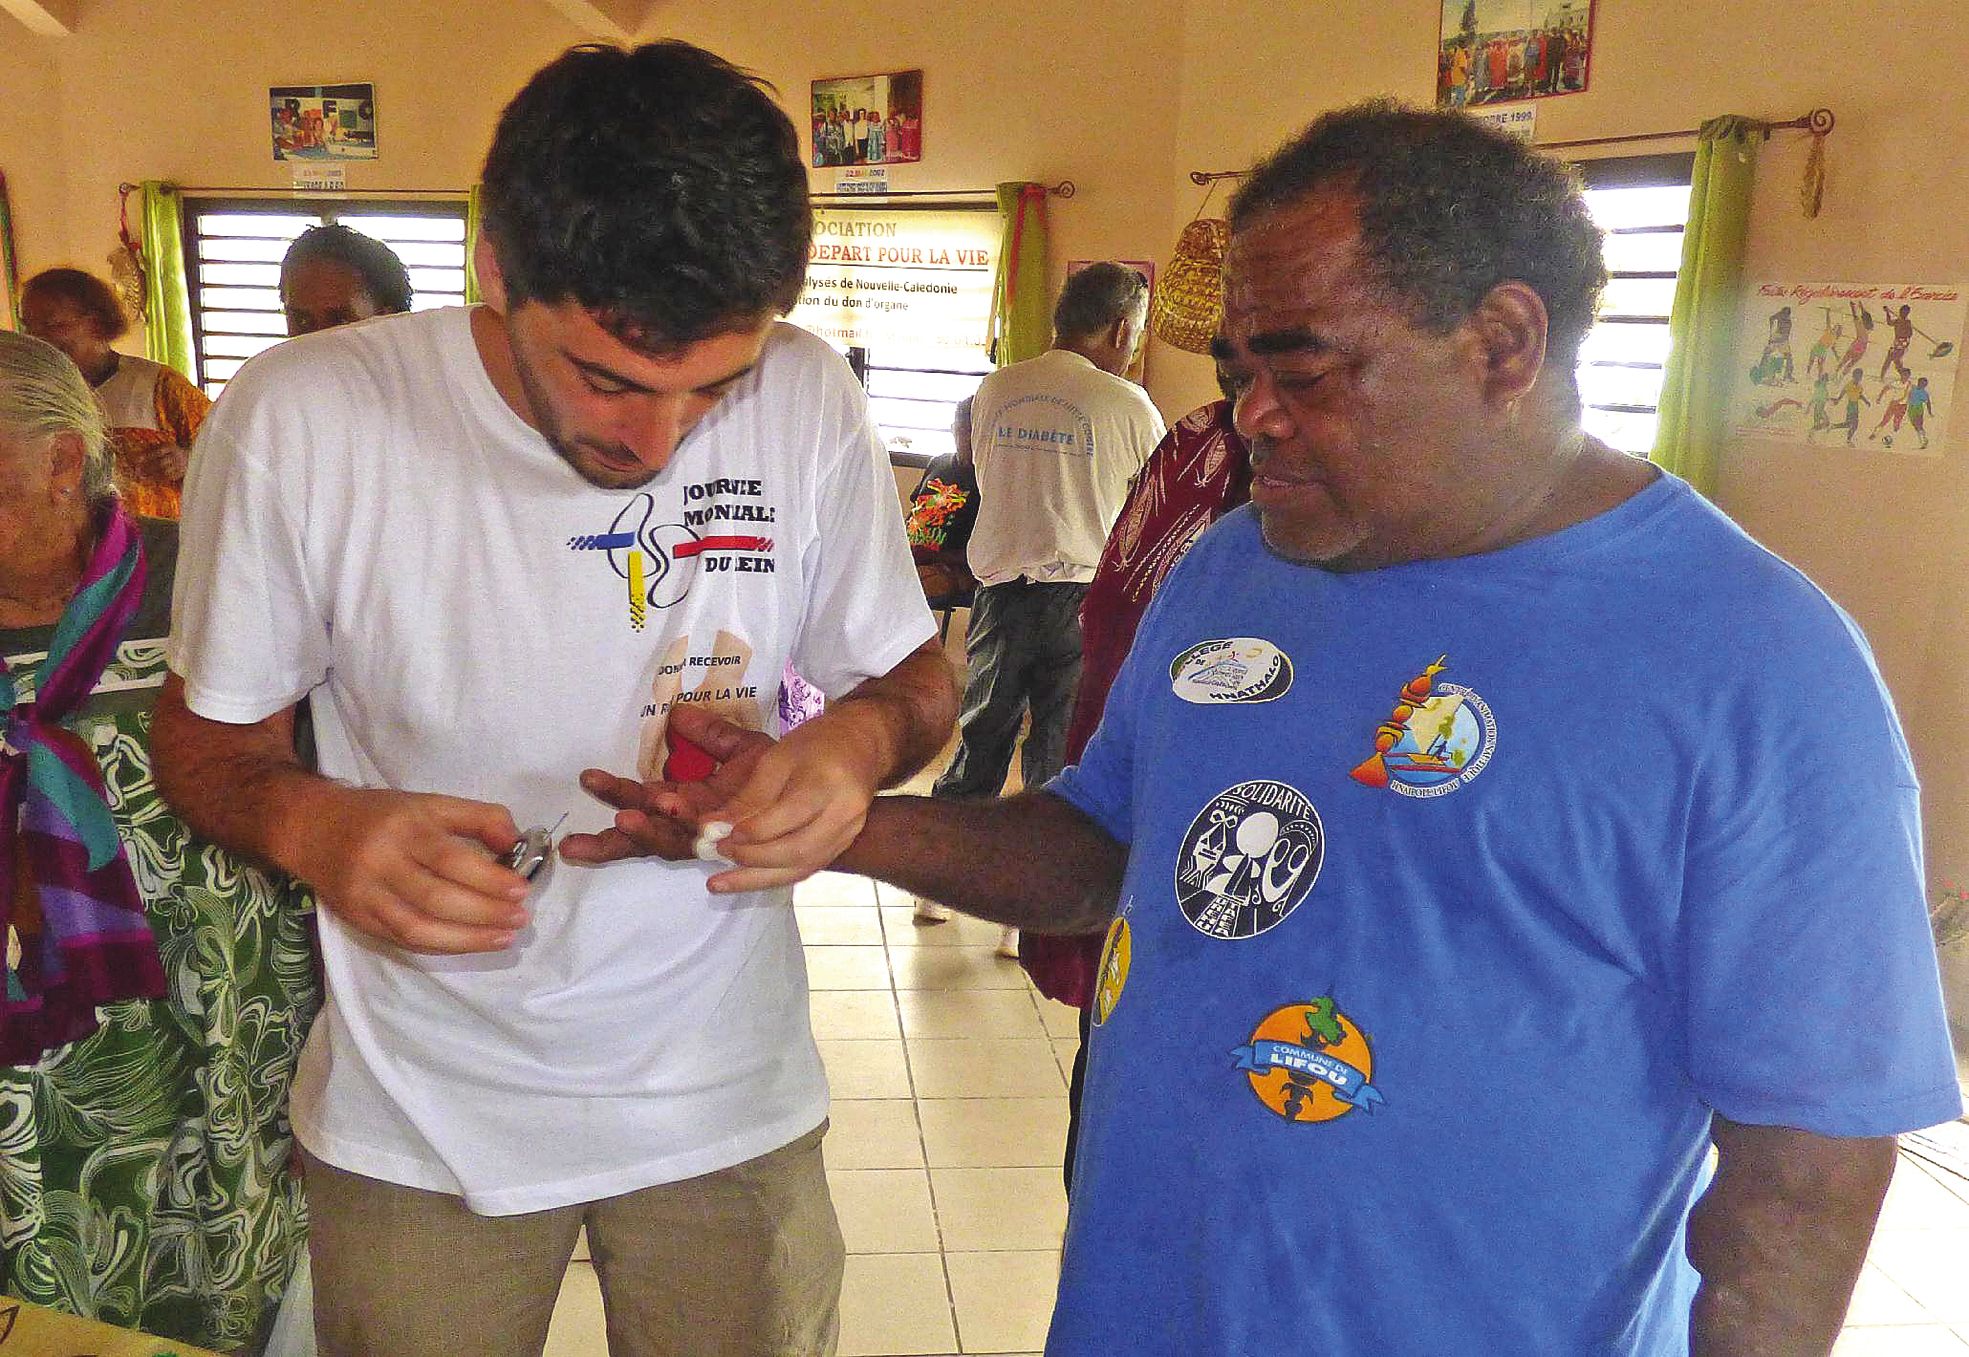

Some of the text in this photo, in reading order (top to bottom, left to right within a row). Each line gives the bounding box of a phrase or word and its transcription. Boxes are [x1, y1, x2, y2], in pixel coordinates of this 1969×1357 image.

[813, 221, 897, 237] OCIATION
[808, 245, 990, 266] DEPART POUR LA VIE
[803, 276, 837, 290] alysés
[840, 277, 854, 289] de
[797, 295, 909, 313] tion du don d'organe
[998, 426, 1013, 439] LE
[683, 504, 775, 527] MONIAL
[705, 557, 775, 573] DU EIN
[689, 655, 741, 667] RECEVOIR
[1209, 655, 1279, 700] HNATHALO
[676, 690, 712, 703] POUR
[716, 688, 731, 700] LA
[736, 686, 757, 699] VIE
[1272, 1045, 1334, 1067] COMMUNE
[1270, 1053, 1347, 1085] LIFOU
